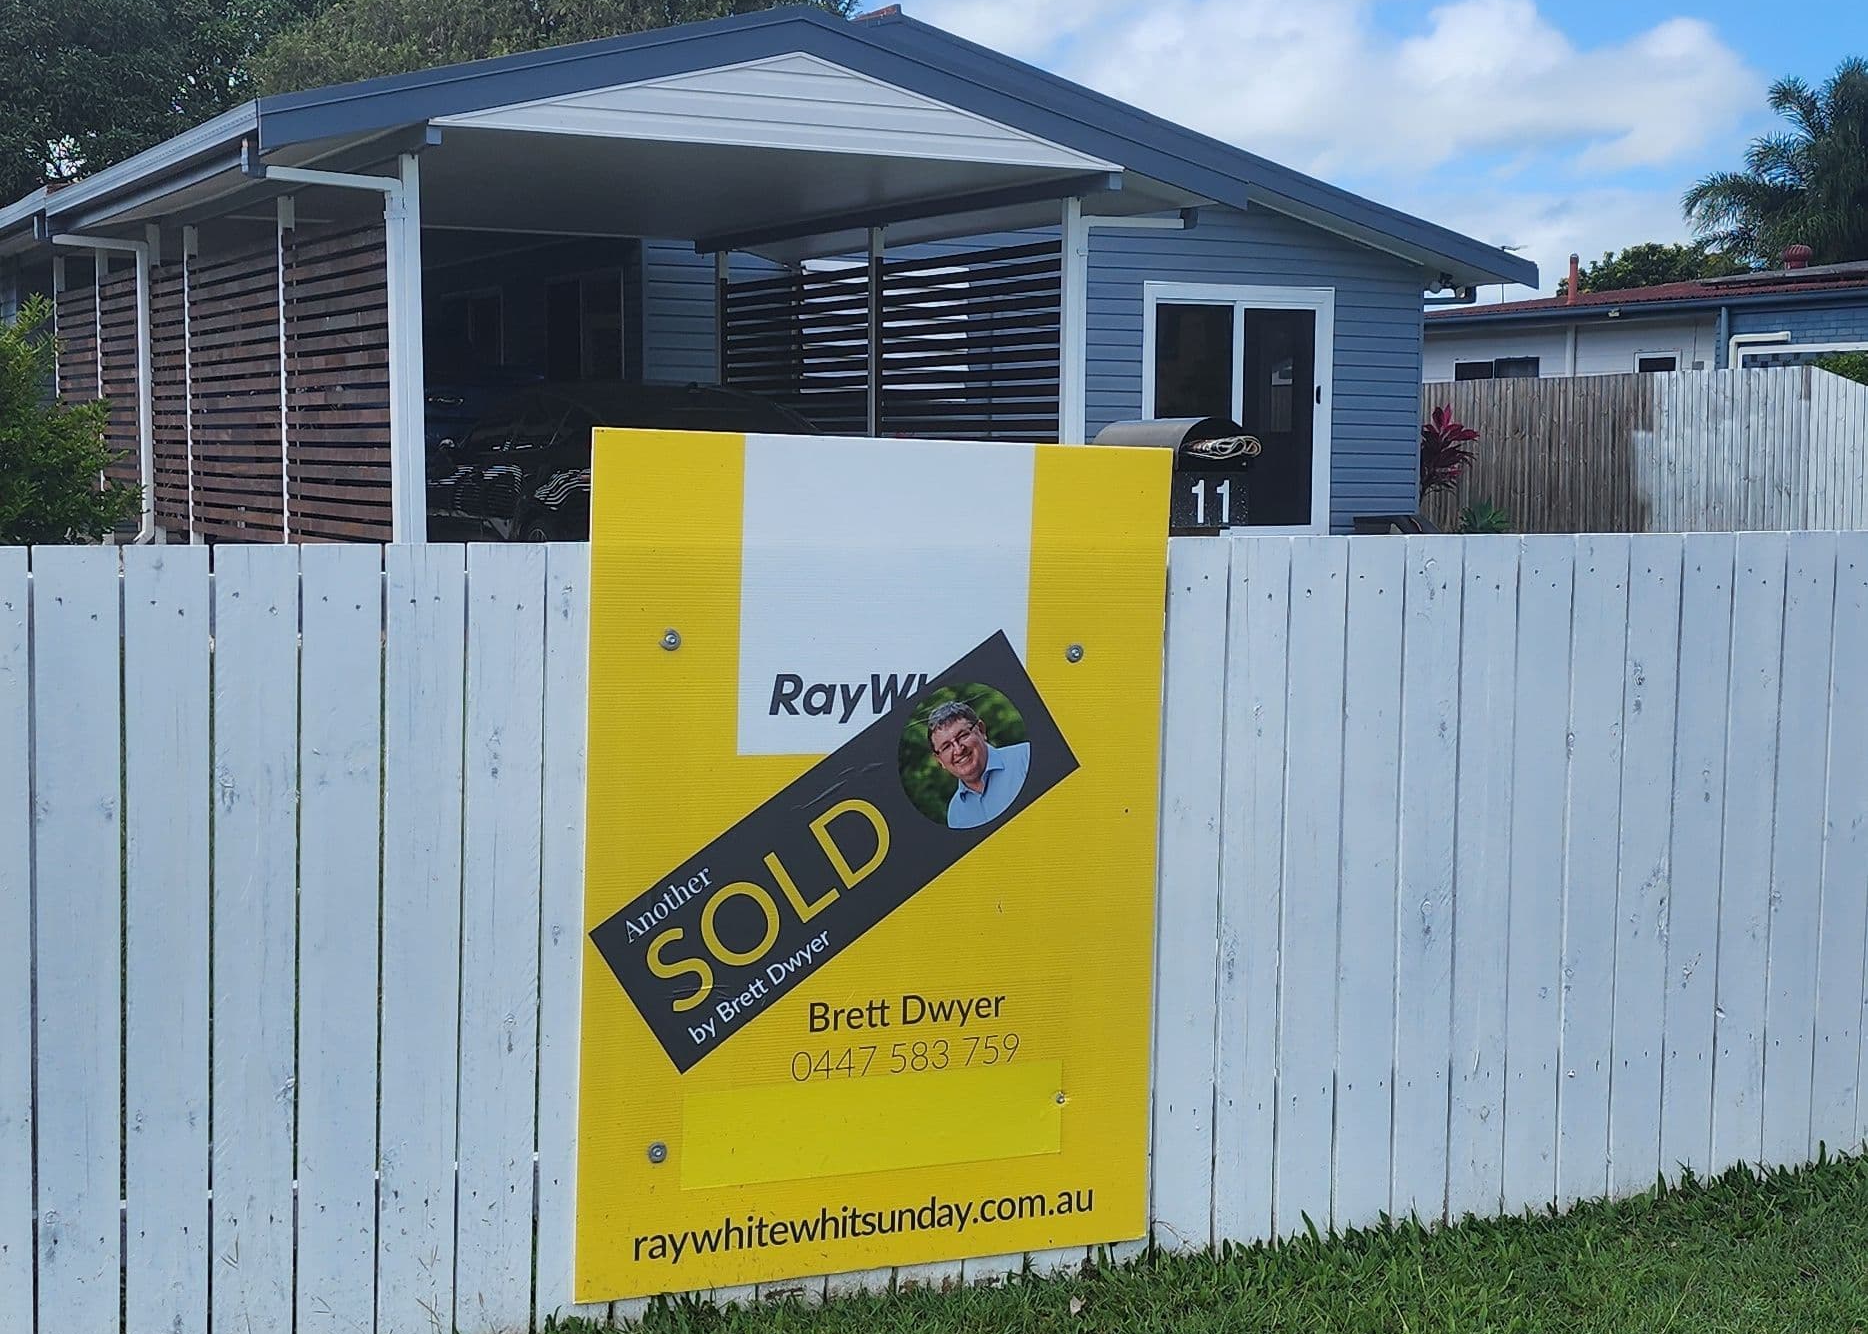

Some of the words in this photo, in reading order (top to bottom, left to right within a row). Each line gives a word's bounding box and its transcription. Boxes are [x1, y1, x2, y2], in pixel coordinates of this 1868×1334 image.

[1192, 479, 1230, 524] 11
[624, 867, 713, 943] Another
[646, 798, 890, 1012] SOLD
[688, 1017, 717, 1044] by
[715, 978, 769, 1024] Brett
[766, 930, 831, 986] Dwyer
[808, 998, 890, 1033] Brett
[901, 994, 1006, 1028] Dwyer
[791, 1045, 877, 1082] 0447
[890, 1039, 949, 1074] 583
[962, 1033, 1020, 1066] 759
[633, 1188, 1094, 1264] raywhitewhitsunday.com.au
